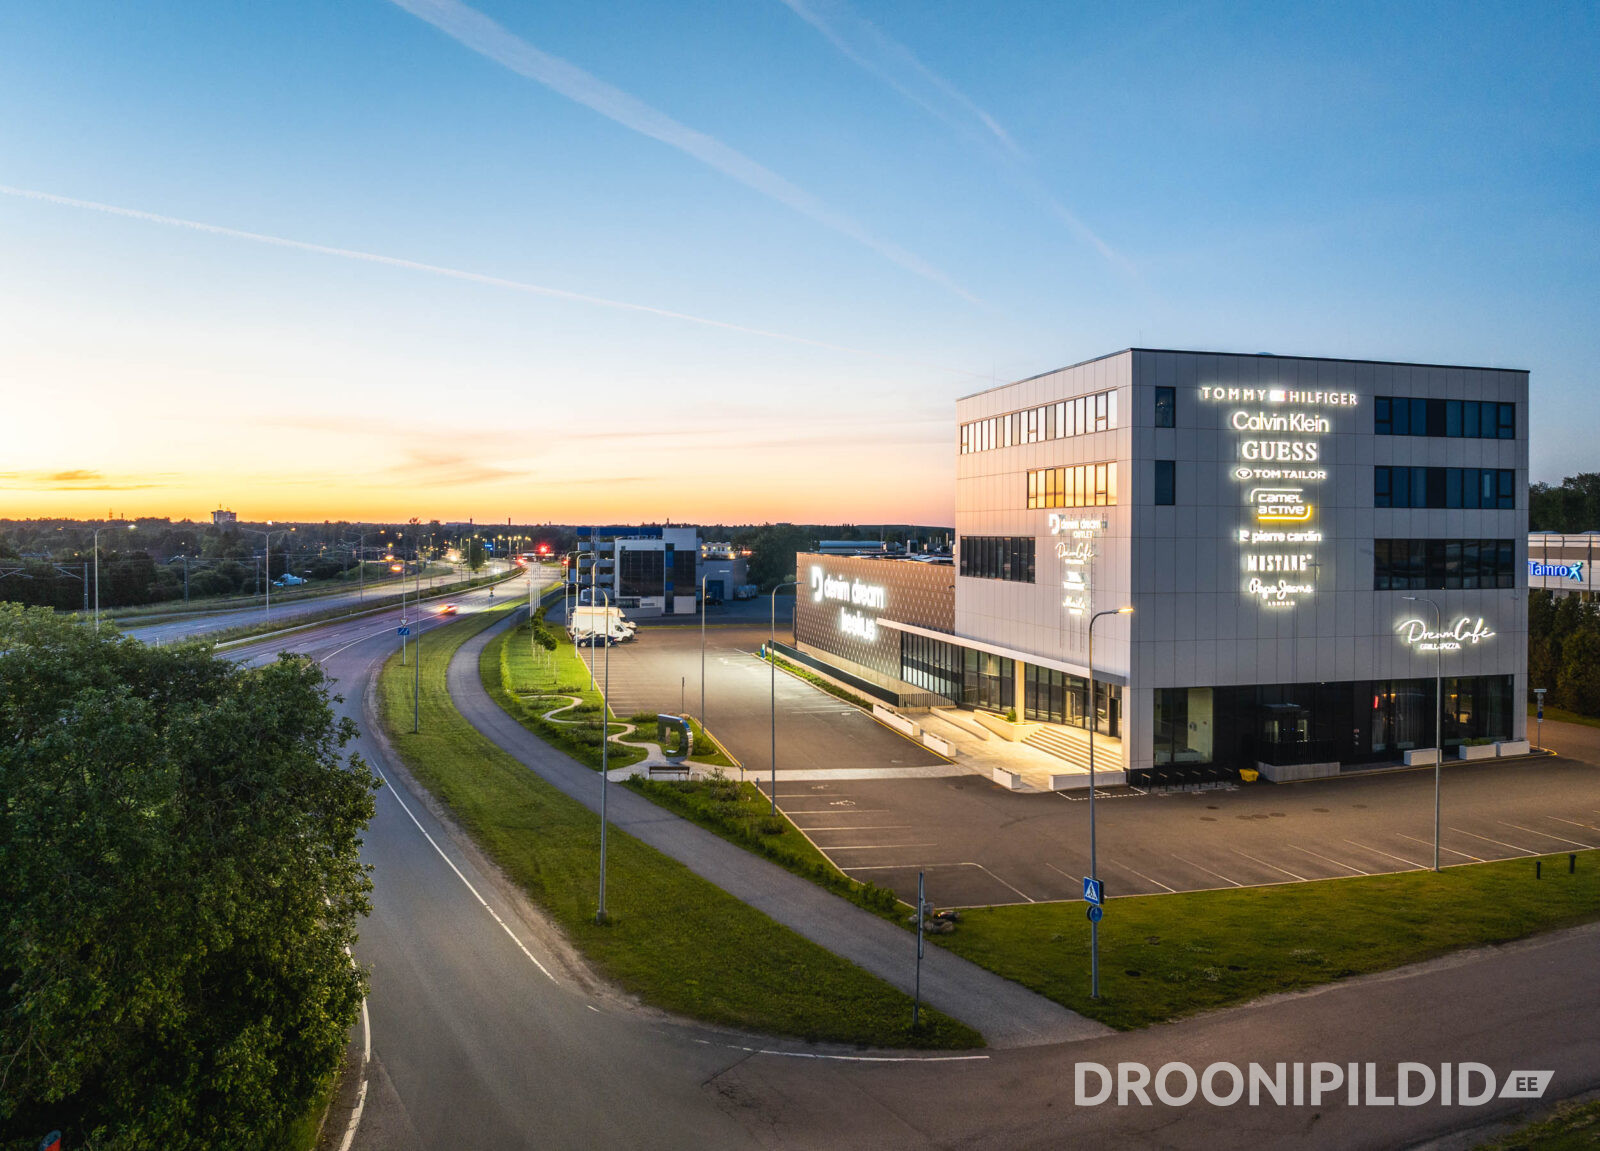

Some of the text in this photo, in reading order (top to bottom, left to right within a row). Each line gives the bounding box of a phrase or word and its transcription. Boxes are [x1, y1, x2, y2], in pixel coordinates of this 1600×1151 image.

[1202, 386, 1358, 405] TOMMY HILFIGER
[1232, 411, 1330, 433] Calvin Klein
[1241, 441, 1318, 461] GUESS
[1253, 469, 1327, 480] TOM TAILOR
[1251, 530, 1322, 544] pierre cardin
[1528, 561, 1569, 576] Tamro
